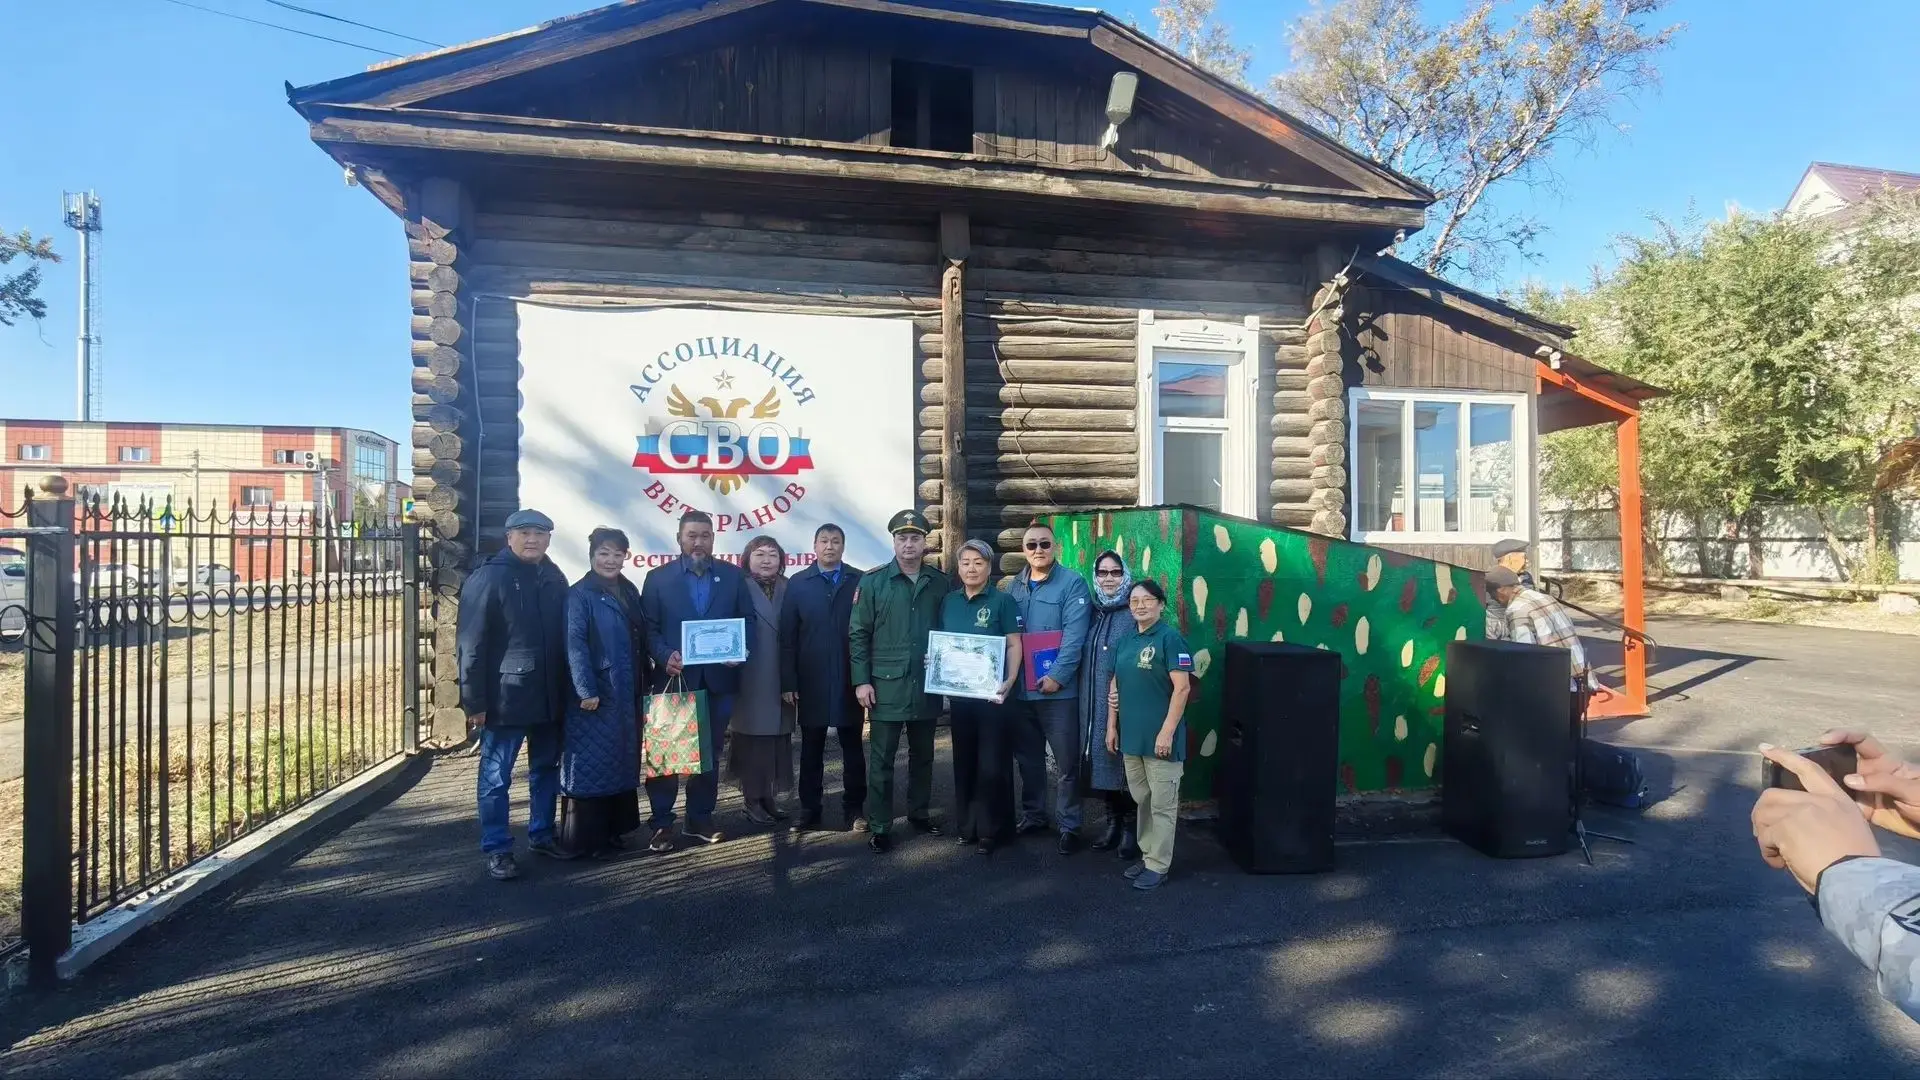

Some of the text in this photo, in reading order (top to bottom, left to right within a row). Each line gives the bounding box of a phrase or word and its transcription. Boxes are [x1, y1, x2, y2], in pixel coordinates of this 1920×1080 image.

[629, 336, 816, 406] АССОЦИАЦИЯ
[657, 419, 791, 471] СВО
[642, 479, 806, 532] ВЕТРАНОВ
